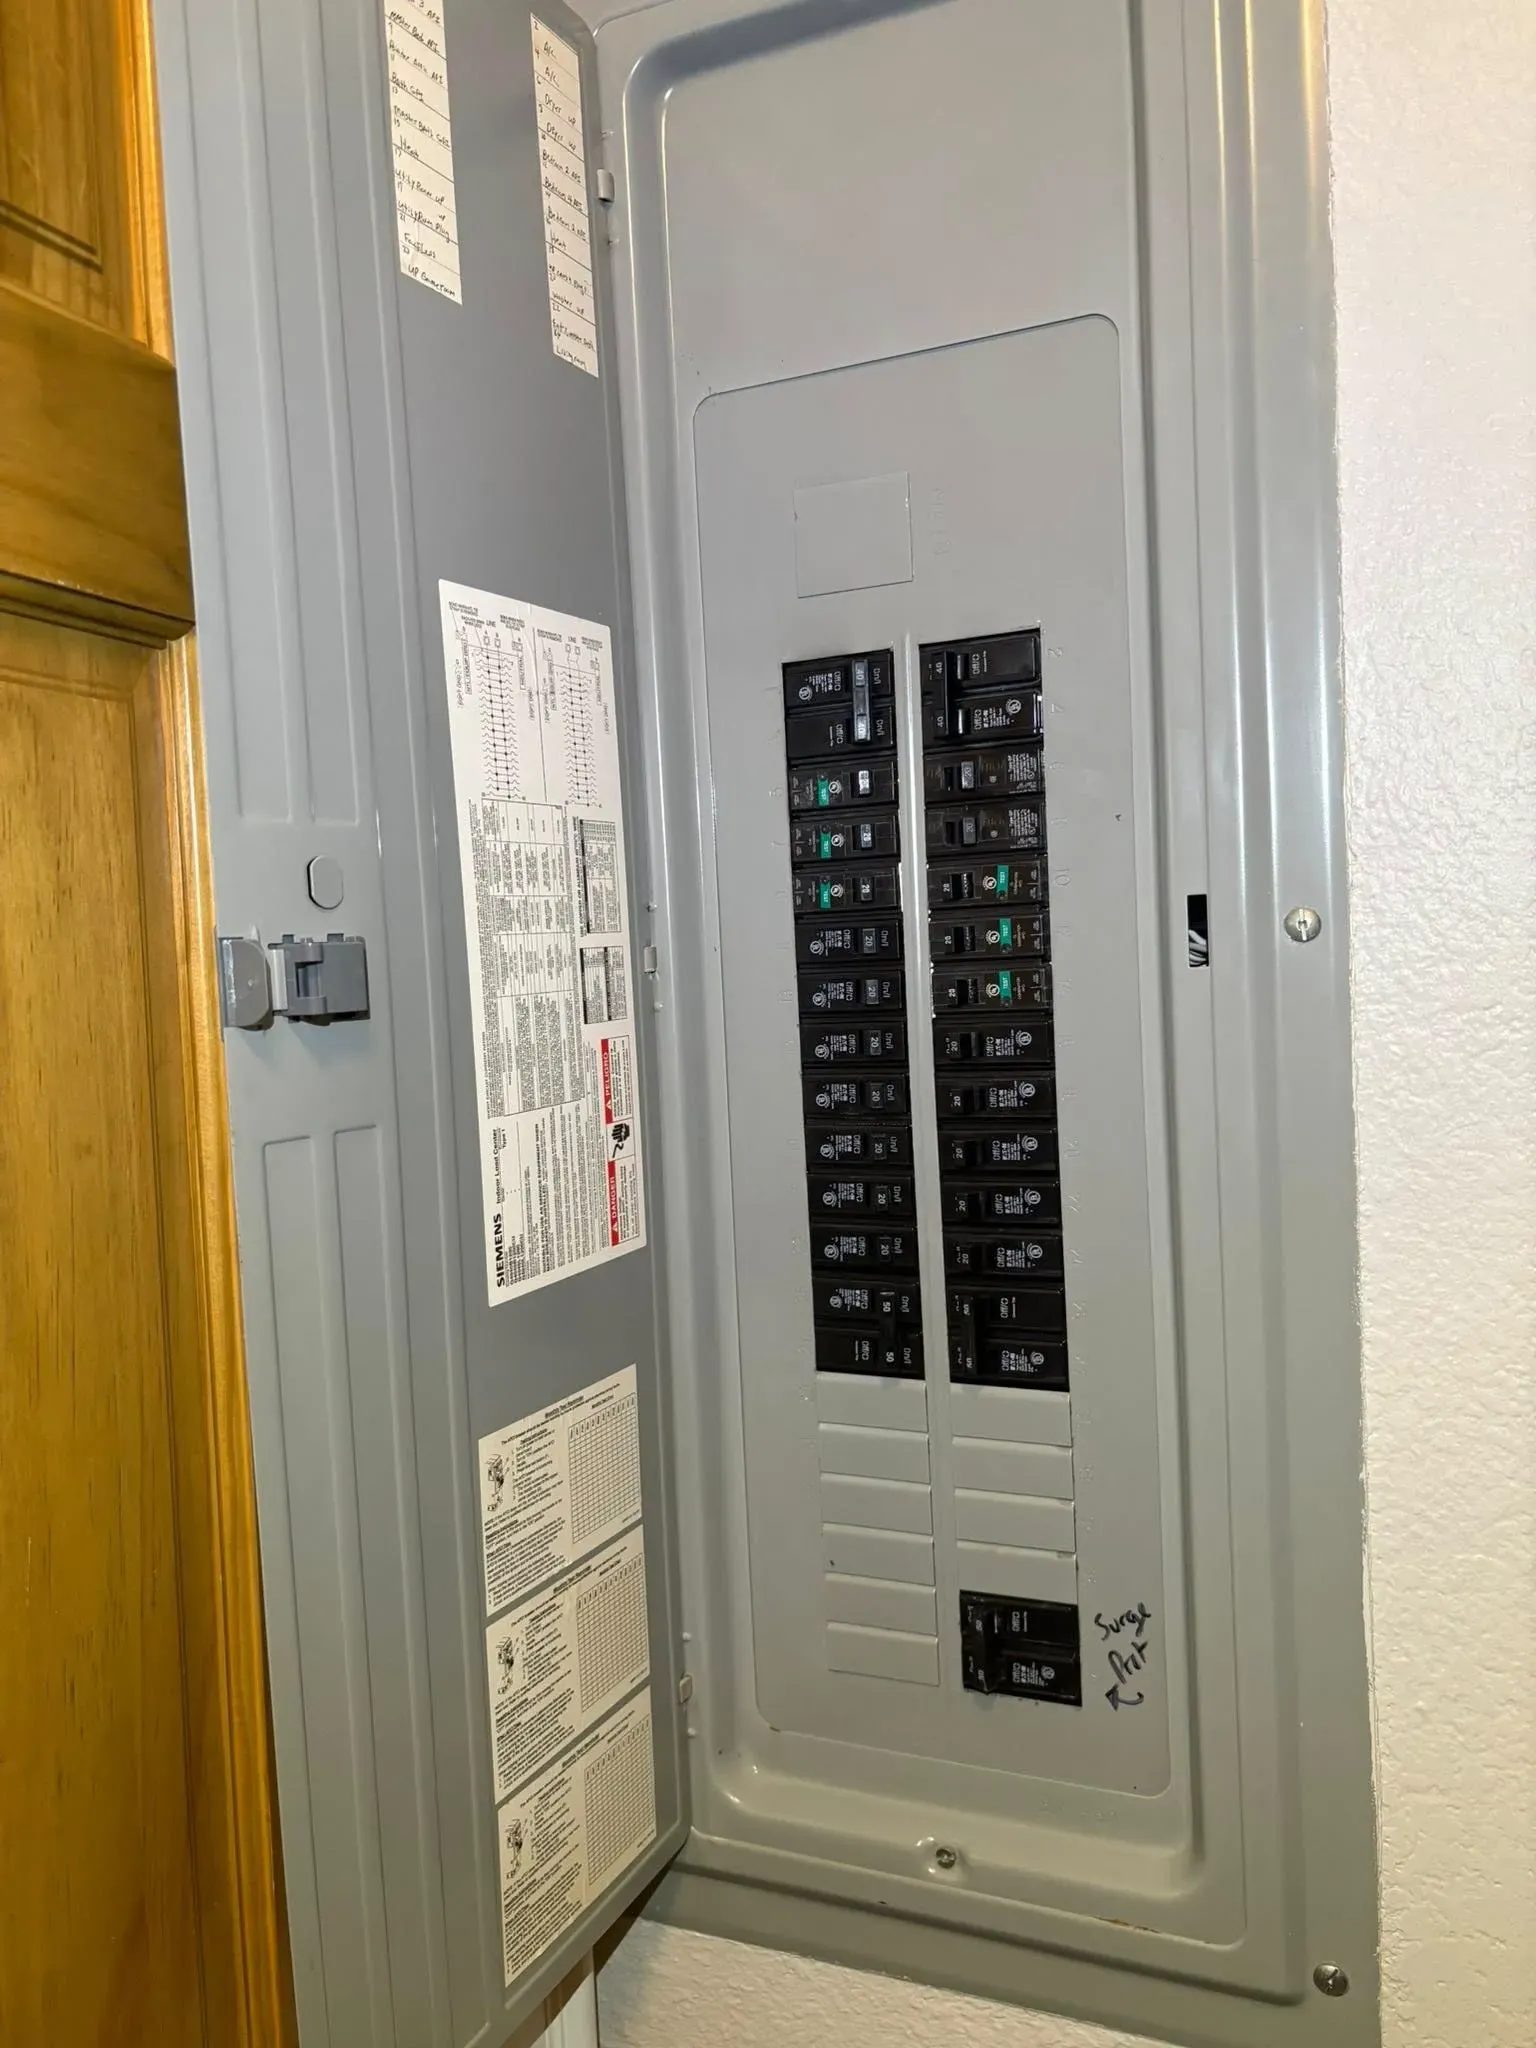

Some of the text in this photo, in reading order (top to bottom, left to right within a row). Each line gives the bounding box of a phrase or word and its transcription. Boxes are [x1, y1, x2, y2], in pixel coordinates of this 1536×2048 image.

[534, 21, 539, 31] 2
[936, 662, 943, 673] 40
[937, 716, 944, 728] 40
[862, 884, 870, 894] 20
[943, 883, 950, 893] 20
[865, 935, 873, 947] 20
[944, 935, 952, 945] 20
[868, 987, 876, 998] 20
[870, 1037, 879, 1048] 20
[951, 1041, 958, 1052] 20
[872, 1090, 880, 1102] 20
[954, 1096, 961, 1107] 20
[874, 1142, 883, 1154] 20
[956, 1148, 963, 1159] 20
[609, 1176, 617, 1220] DANGER
[878, 1193, 886, 1205] 20
[959, 1200, 966, 1211] 20
[493, 1213, 505, 1287] SIEMENS
[880, 1244, 889, 1256] 20
[962, 1253, 969, 1264] 20
[882, 1302, 891, 1312] 50
[885, 1352, 894, 1362] 50
[1094, 1602, 1152, 1641] Surge
